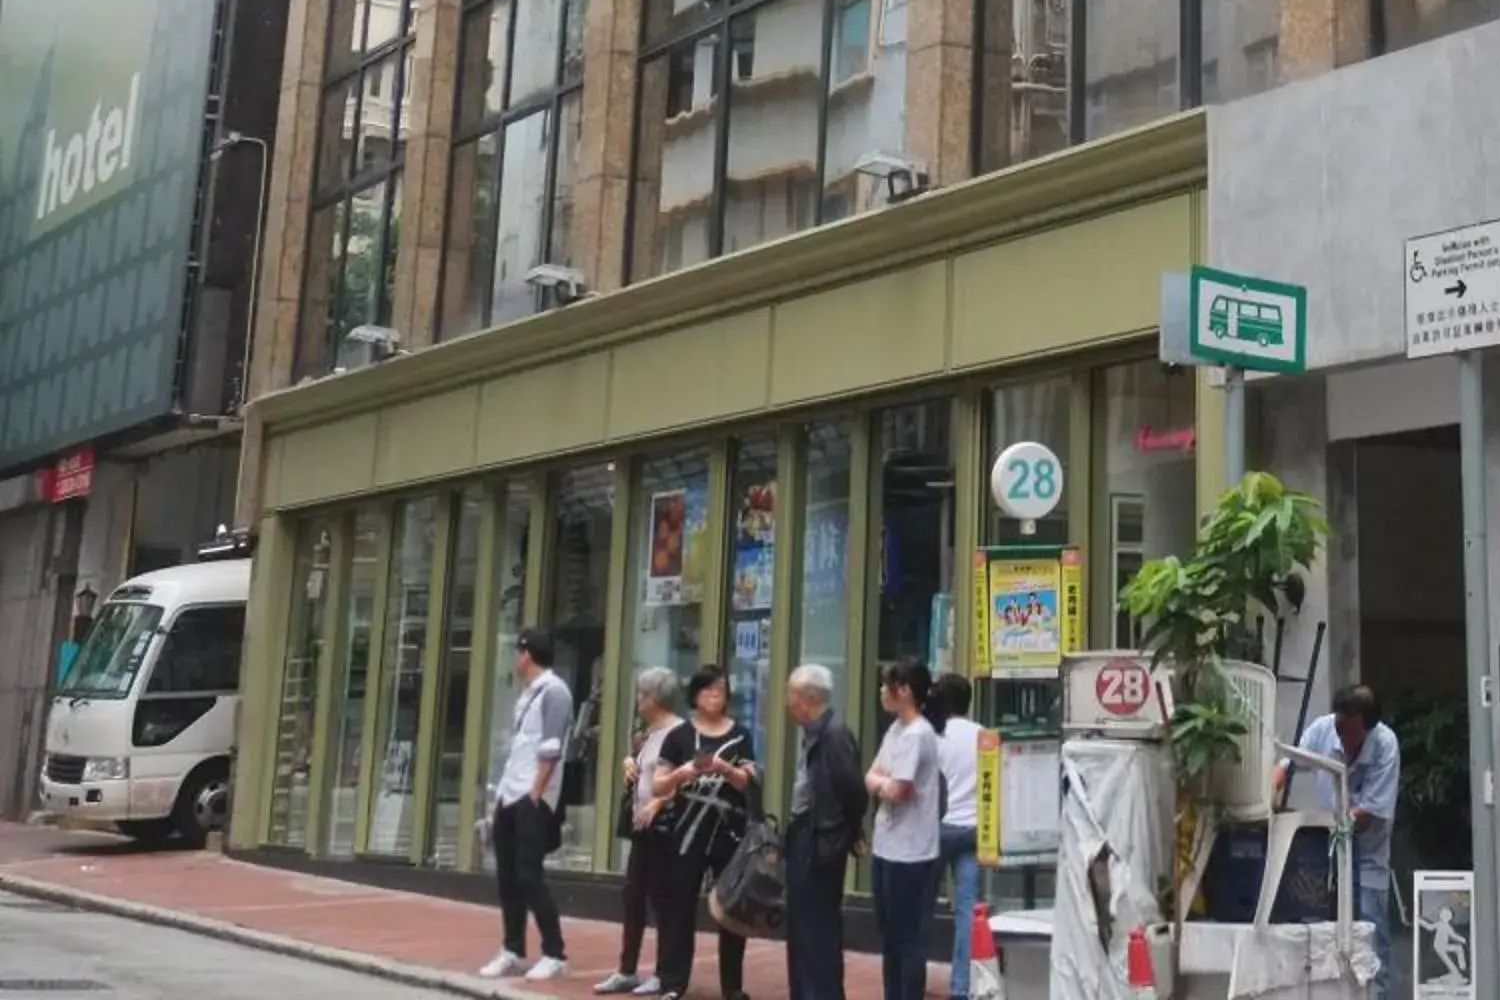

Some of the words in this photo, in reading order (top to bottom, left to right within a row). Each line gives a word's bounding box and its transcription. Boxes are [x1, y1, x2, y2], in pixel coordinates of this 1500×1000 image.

[37, 71, 140, 219] hotel
[1007, 459, 1056, 499] 28
[1101, 669, 1144, 704] 28
